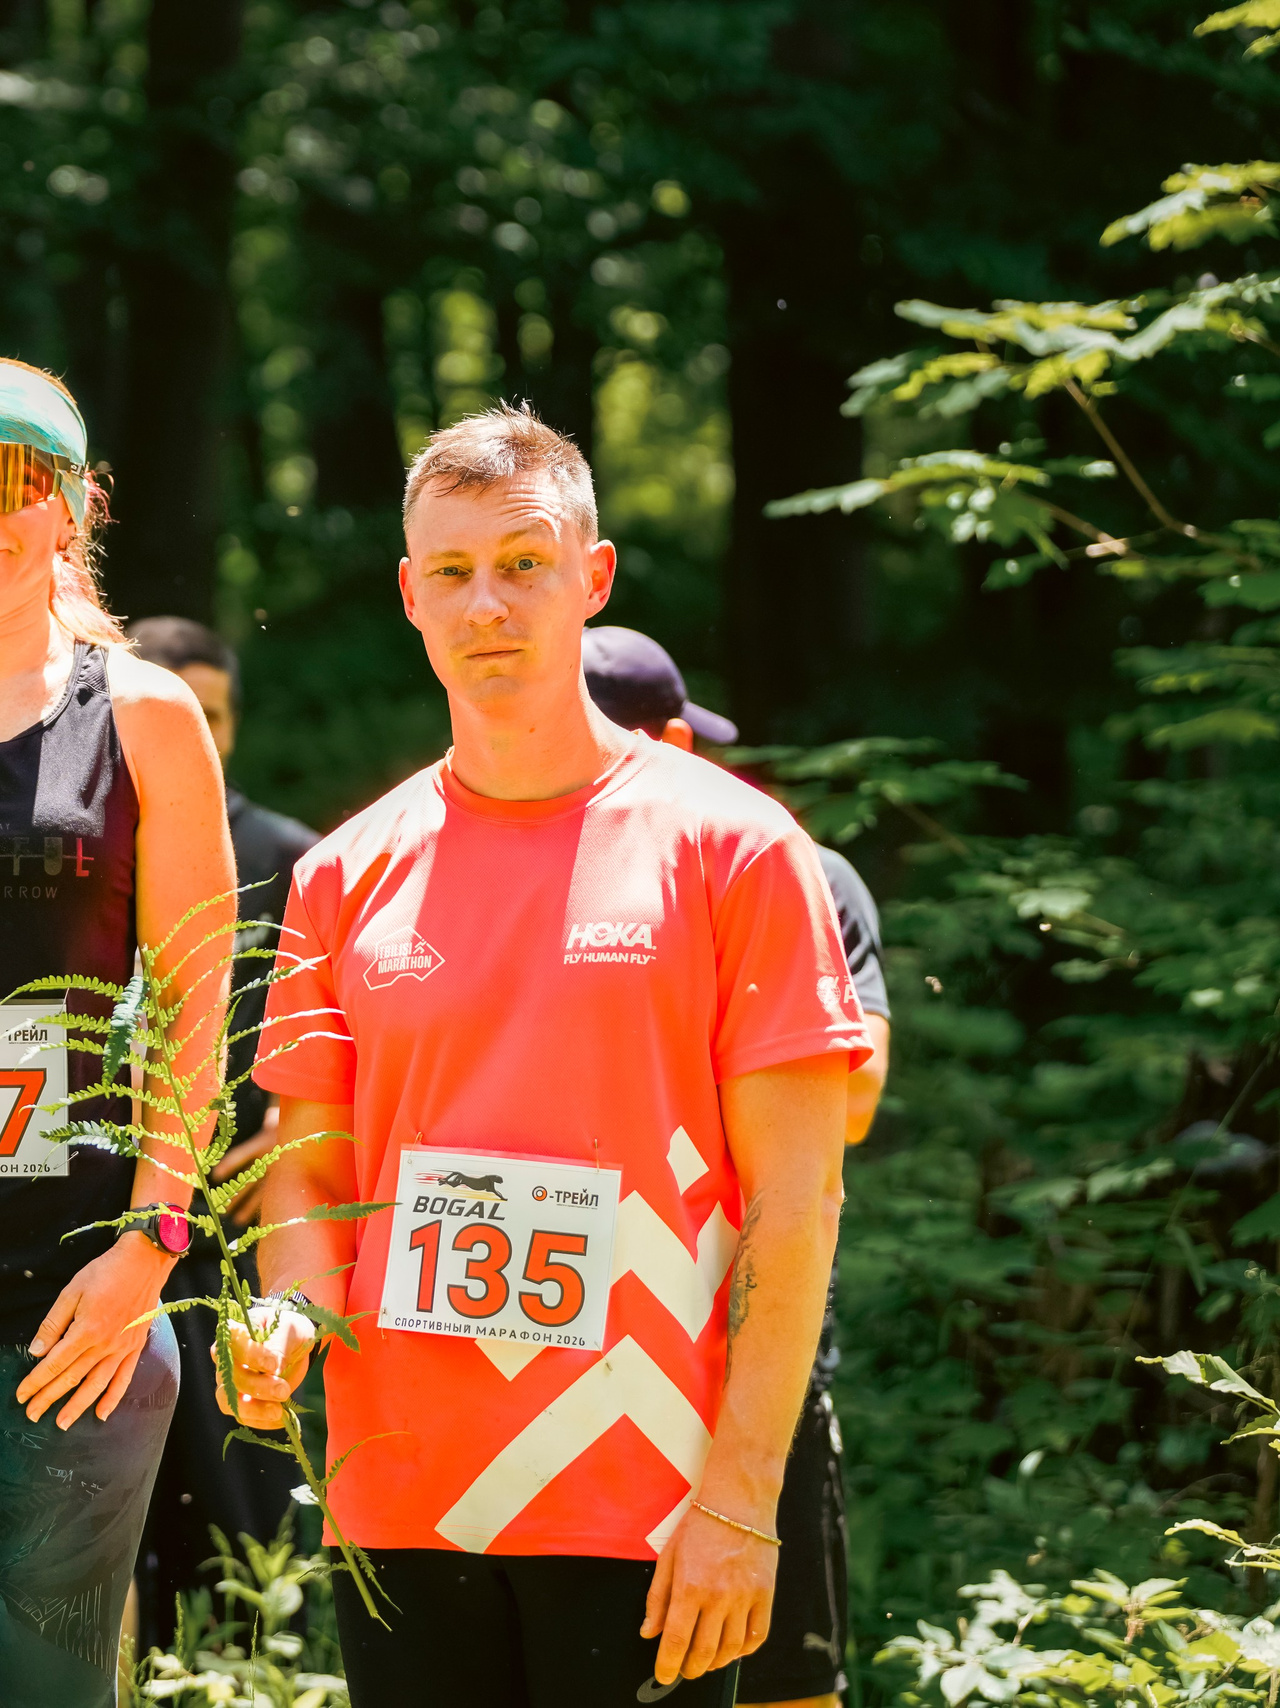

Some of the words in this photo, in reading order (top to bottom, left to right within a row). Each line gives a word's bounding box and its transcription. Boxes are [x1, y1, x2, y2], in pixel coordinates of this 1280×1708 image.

[566, 921, 654, 949] HOKA
[380, 942, 412, 958] TBILISI
[563, 953, 582, 965] FLY
[583, 952, 629, 963] HUMAN
[378, 955, 432, 974] MARATHON
[23, 1163, 51, 1173] 2026
[412, 1195, 506, 1221] BOGAL
[409, 1218, 589, 1328] 135
[394, 1317, 471, 1334] СПОРТИВНЫЙ
[476, 1326, 552, 1343] МАРАФОН
[556, 1334, 586, 1347] 2026
